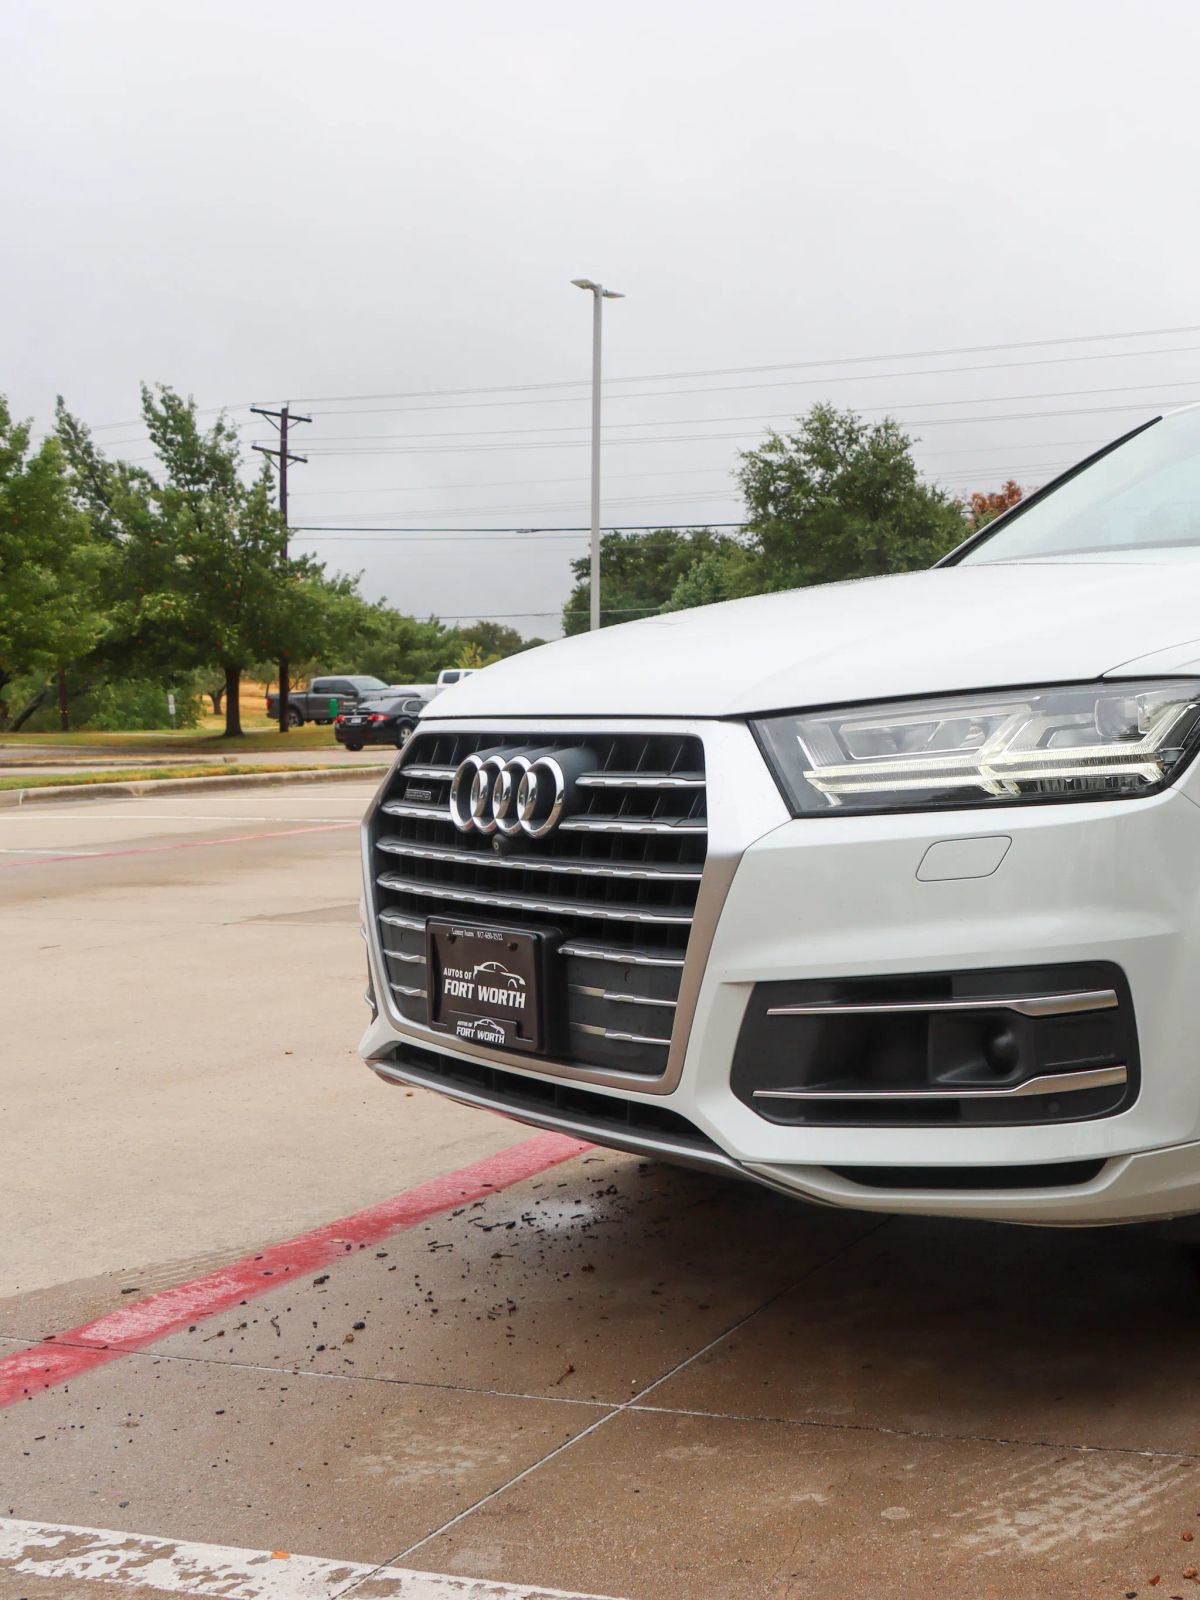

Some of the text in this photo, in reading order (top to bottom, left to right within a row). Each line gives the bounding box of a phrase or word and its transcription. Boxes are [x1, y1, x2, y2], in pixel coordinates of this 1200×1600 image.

[443, 967, 472, 981] AUTOS OF
[444, 978, 526, 1009] FORT WORTH
[456, 1026, 505, 1045] FORT WORTH
